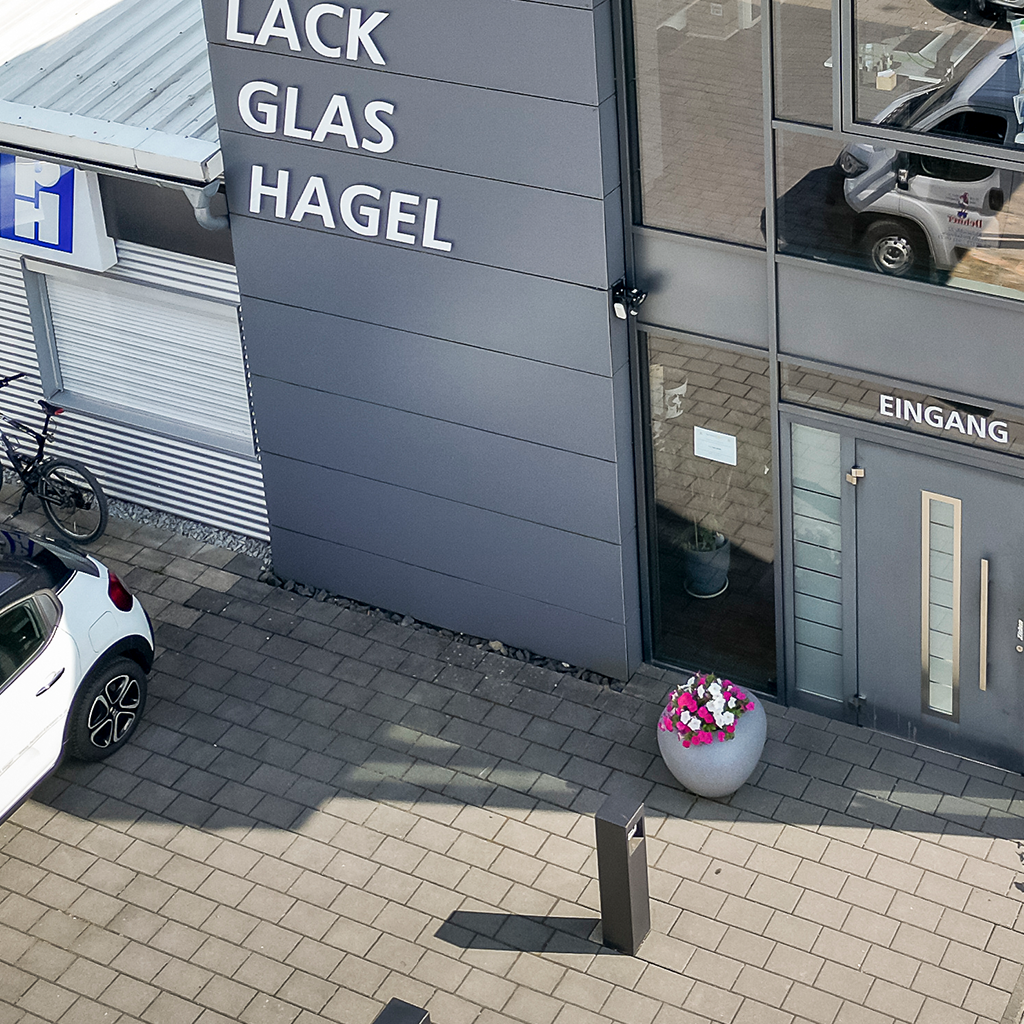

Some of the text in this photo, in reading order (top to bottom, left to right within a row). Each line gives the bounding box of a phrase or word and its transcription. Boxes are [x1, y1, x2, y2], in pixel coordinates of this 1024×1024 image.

[236, 80, 395, 154] GLAS
[248, 164, 453, 252] HAGEL
[878, 393, 1009, 444] EINGANG
